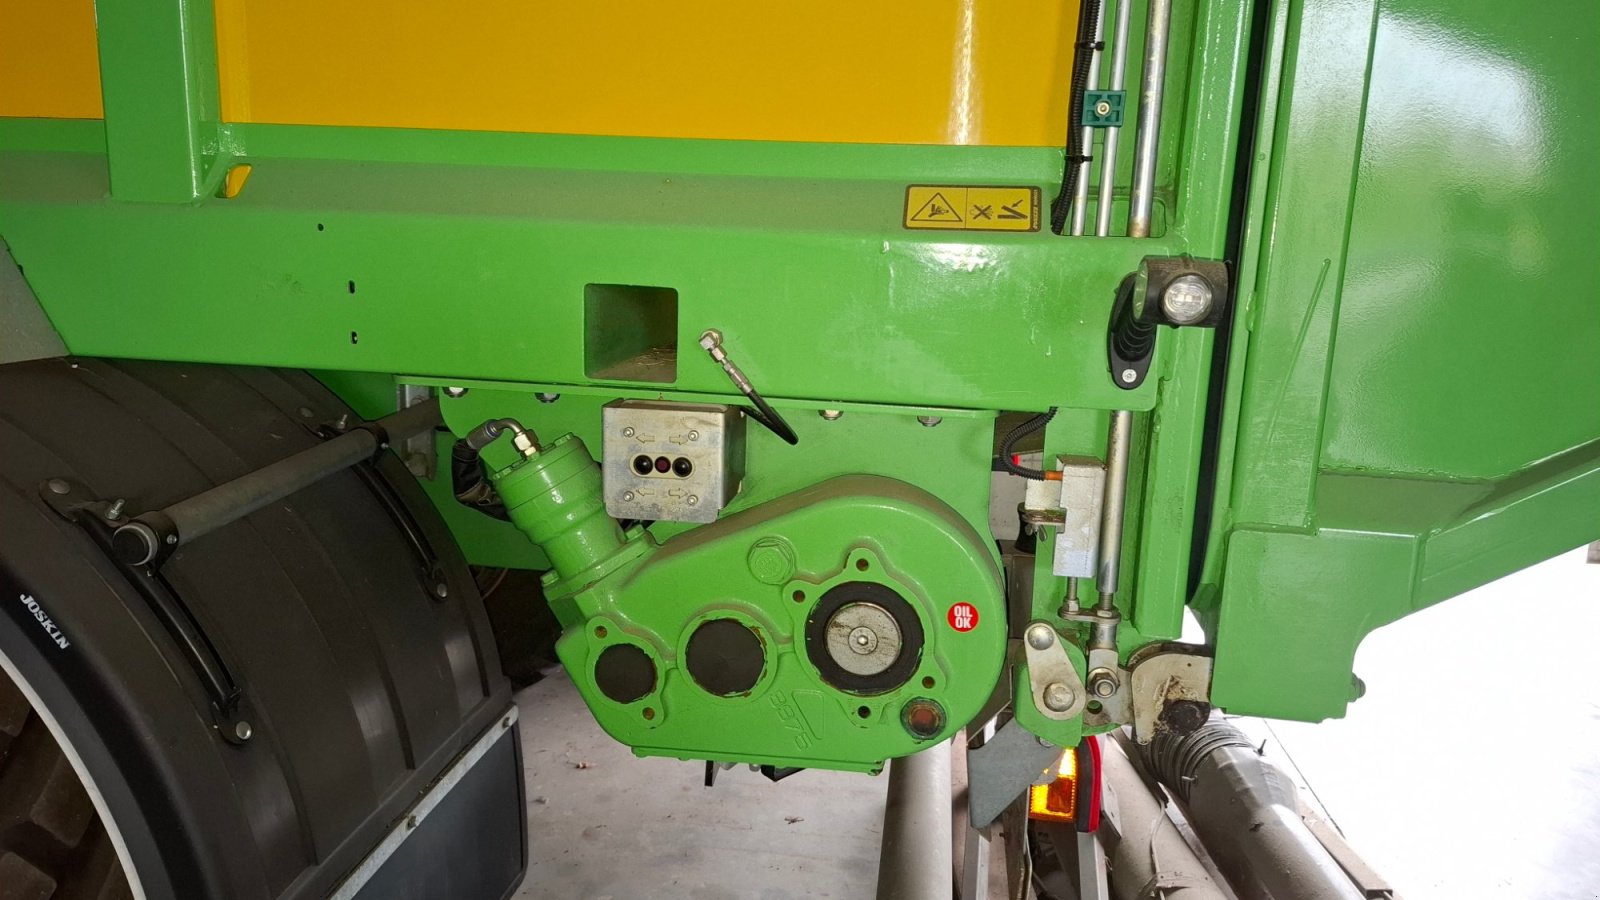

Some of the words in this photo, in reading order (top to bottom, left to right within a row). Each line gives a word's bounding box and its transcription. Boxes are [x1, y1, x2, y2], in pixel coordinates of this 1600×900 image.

[953, 605, 973, 617] OIL
[19, 593, 71, 650] JOSKIN
[955, 617, 972, 629] OK
